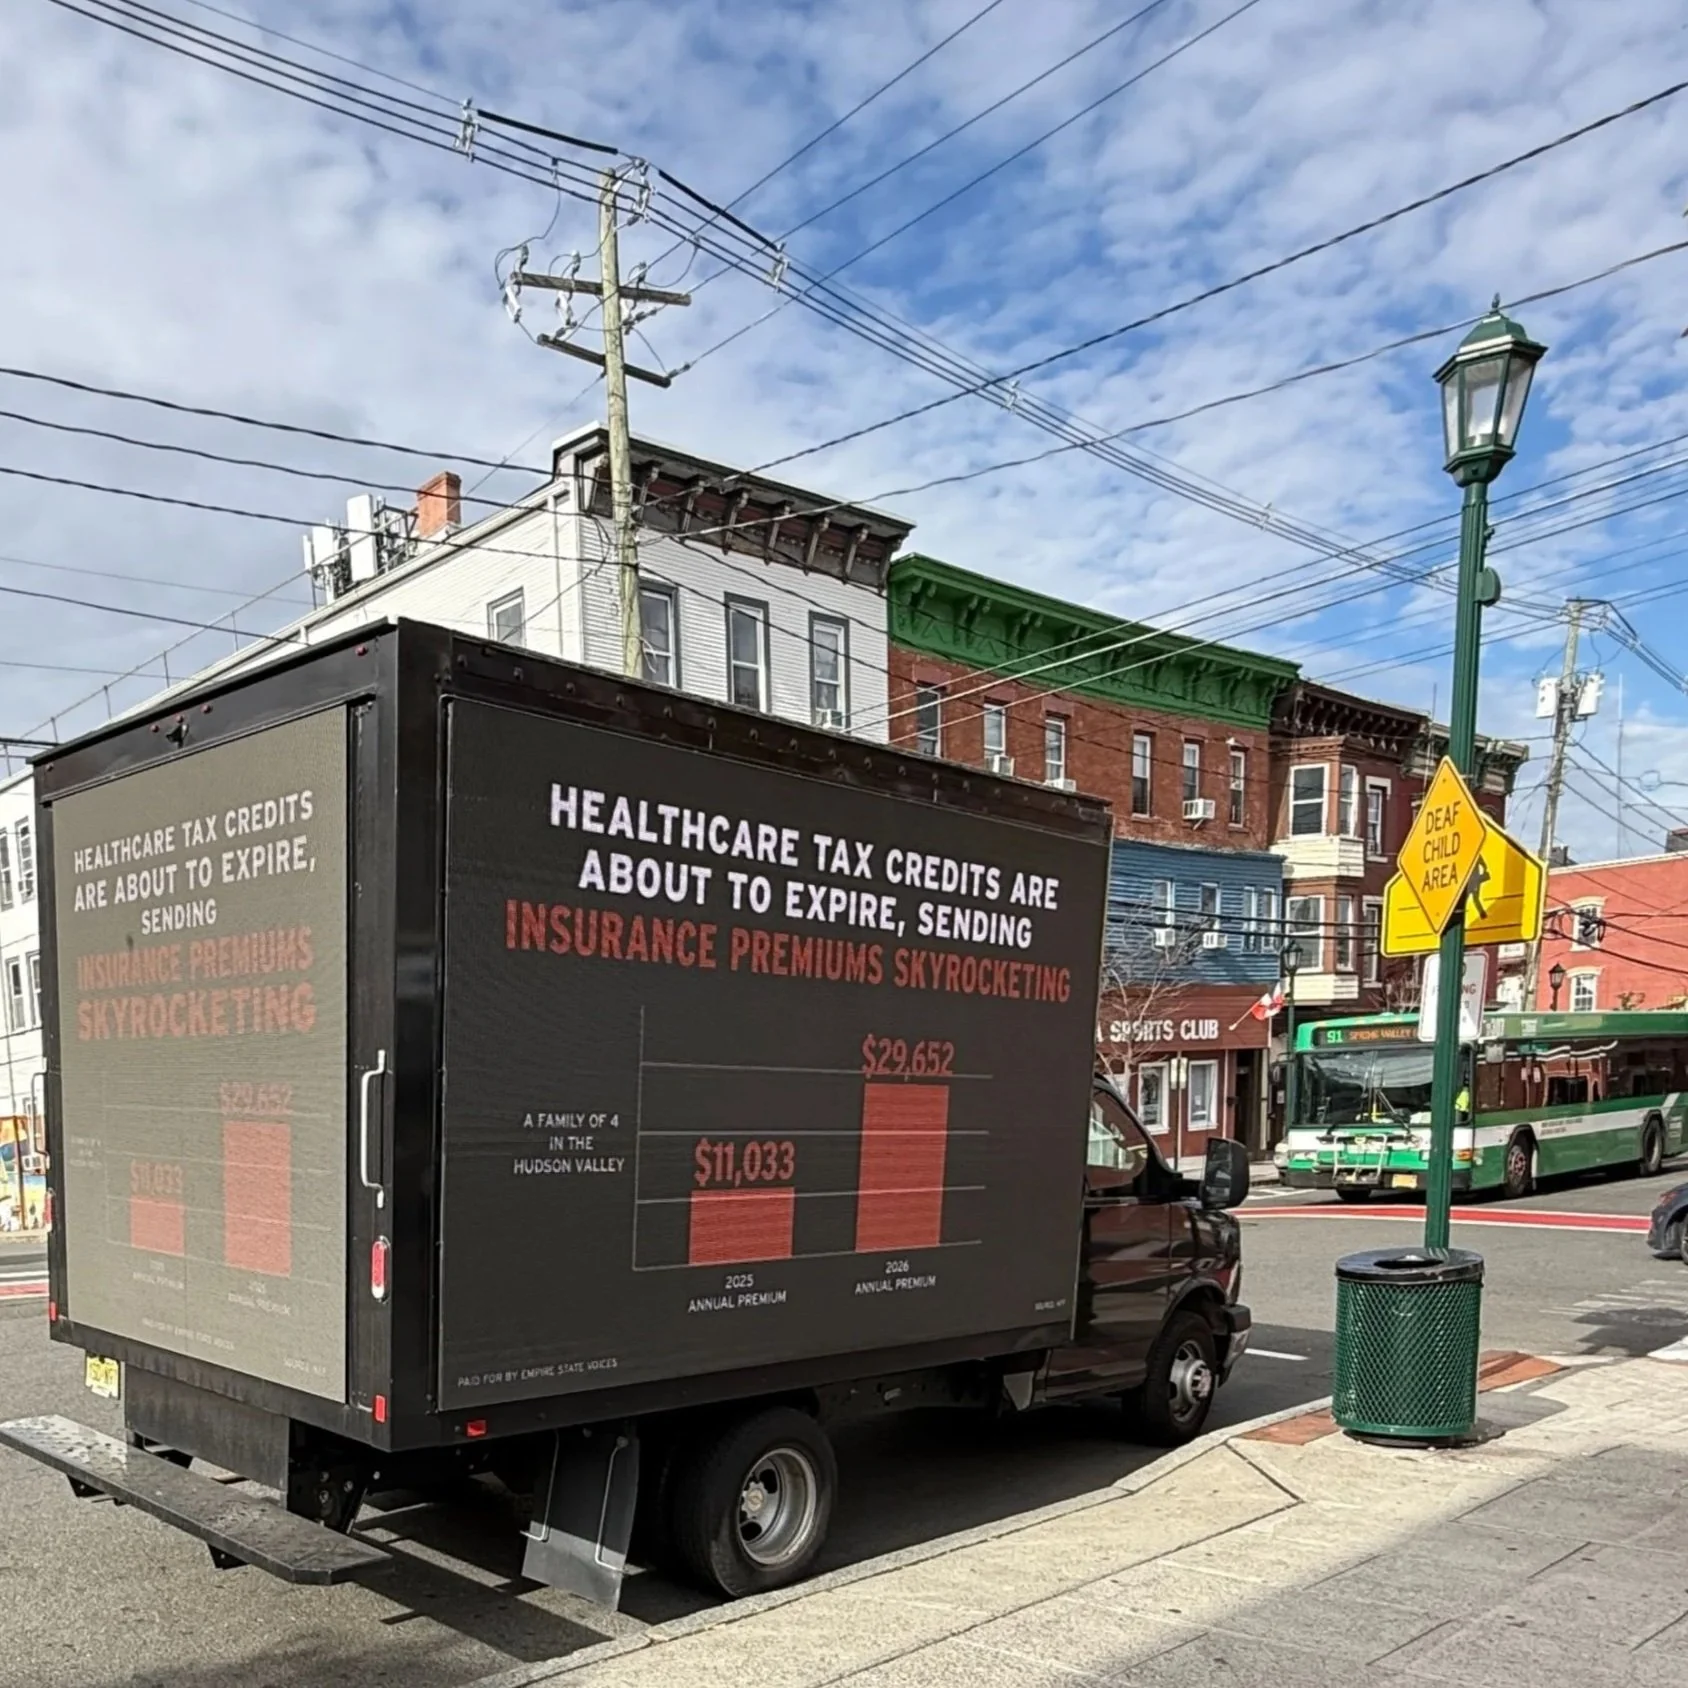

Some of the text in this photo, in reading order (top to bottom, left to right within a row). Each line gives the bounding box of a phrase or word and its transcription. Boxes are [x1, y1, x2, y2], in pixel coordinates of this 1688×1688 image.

[74, 790, 314, 874] HEALTHCARE TAX CREDITS
[1425, 801, 1461, 835] DEAF
[550, 782, 1060, 910] HEALTHCARE TAX CREDITS ARE
[1423, 833, 1460, 864] CHILD
[74, 836, 316, 912] ARE ABOUT TO EXPIRE,
[1421, 863, 1458, 893] AREA
[578, 849, 1032, 949] ABOUT TO EXPIRE, SENDING
[141, 899, 217, 935] SENDING
[77, 926, 314, 990] INSURANCE PREMIUMS
[505, 899, 1071, 1003] INSURANCE PREMIUMS SKYROCKETING
[76, 981, 317, 1040] SKYROCKETING
[1110, 1019, 1174, 1042] SPORTS
[1180, 1019, 1219, 1041] CLUB
[1326, 1030, 1343, 1044] 91
[861, 1033, 955, 1082] $29,652
[523, 1113, 619, 1128] A FAMILY OF 4
[549, 1136, 594, 1150] IN THE
[513, 1157, 625, 1174] HUDSON VALLEY
[694, 1137, 795, 1187] $11,033
[725, 1274, 754, 1289] 2025
[885, 1260, 909, 1274] 2026
[854, 1275, 937, 1295] ANNUAL PREMIUM
[688, 1290, 787, 1313] ANNUAL PREMIUM
[483, 1373, 502, 1385] FOR
[505, 1371, 518, 1382] BY
[521, 1367, 555, 1380] EMPIRE
[557, 1362, 584, 1375] STATE
[587, 1357, 618, 1370] VOICES
